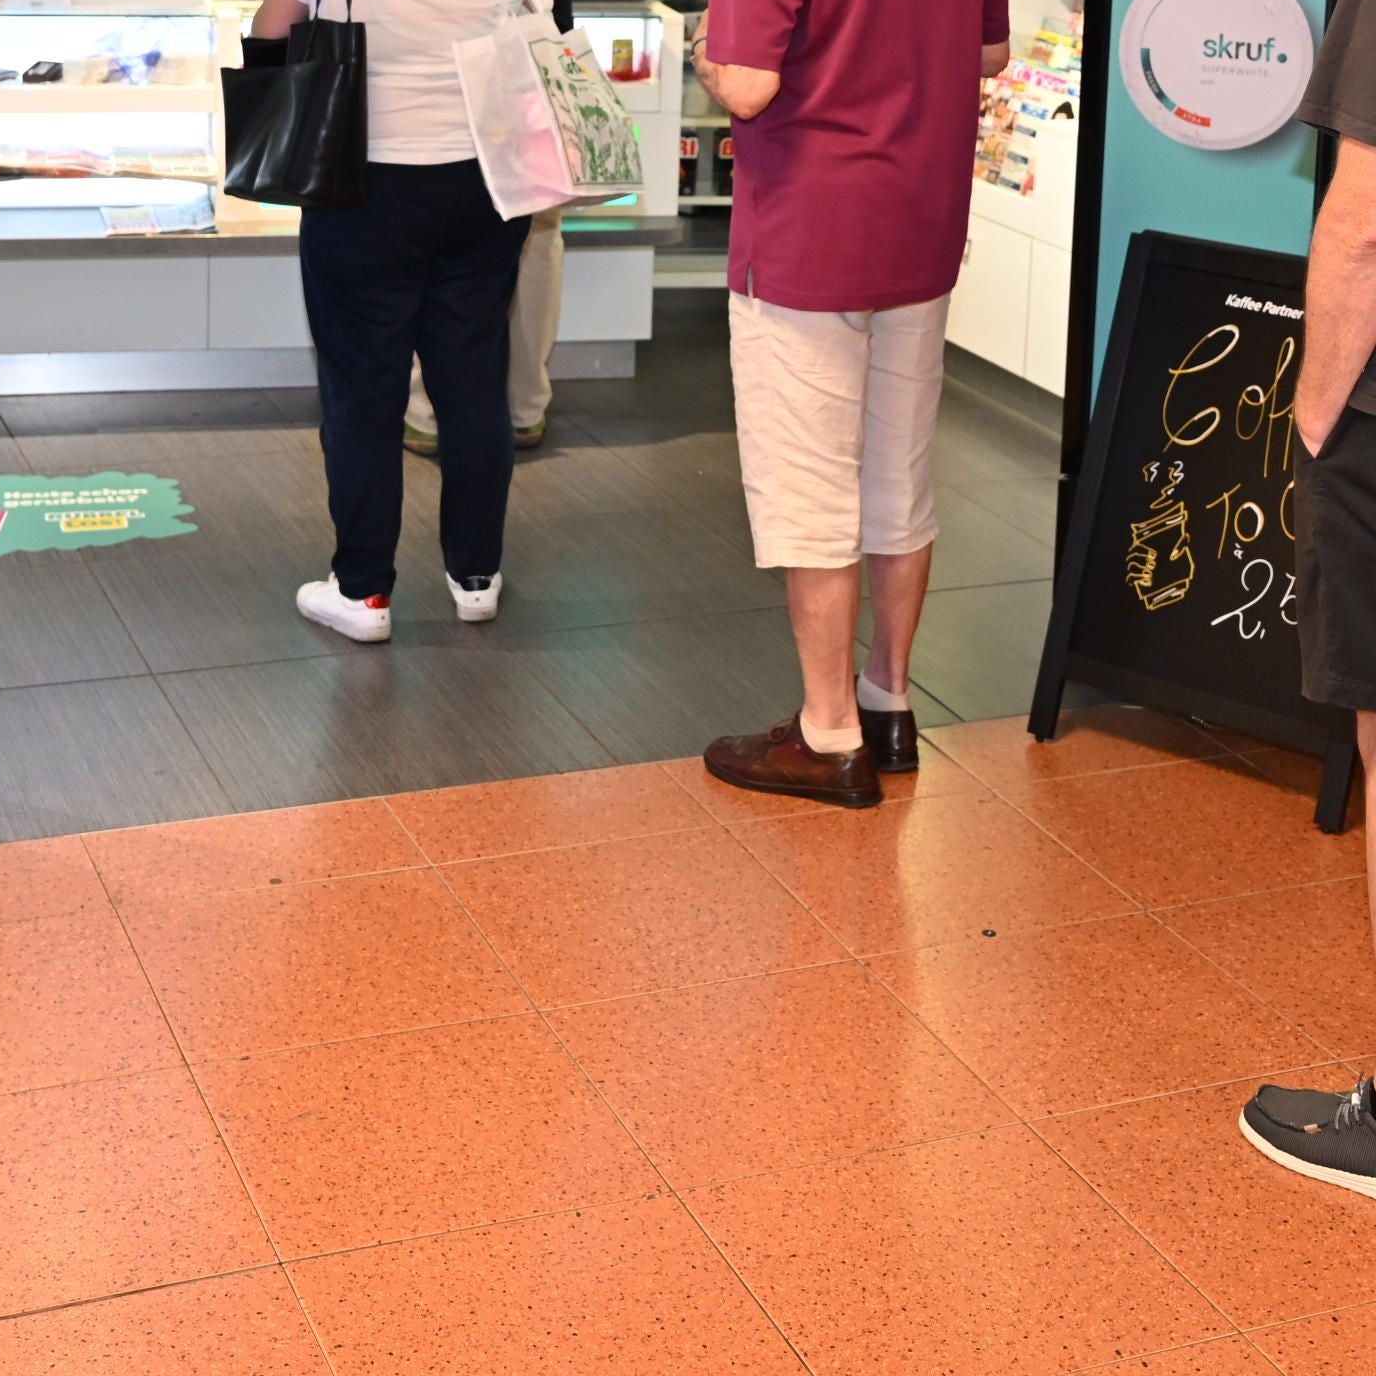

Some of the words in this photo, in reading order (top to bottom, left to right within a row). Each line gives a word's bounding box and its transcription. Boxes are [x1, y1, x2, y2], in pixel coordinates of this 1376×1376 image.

[1202, 33, 1288, 63] skruf.
[1225, 293, 1262, 314] Kaffee
[1261, 298, 1305, 322] Partner
[1162, 324, 1296, 478] Coff
